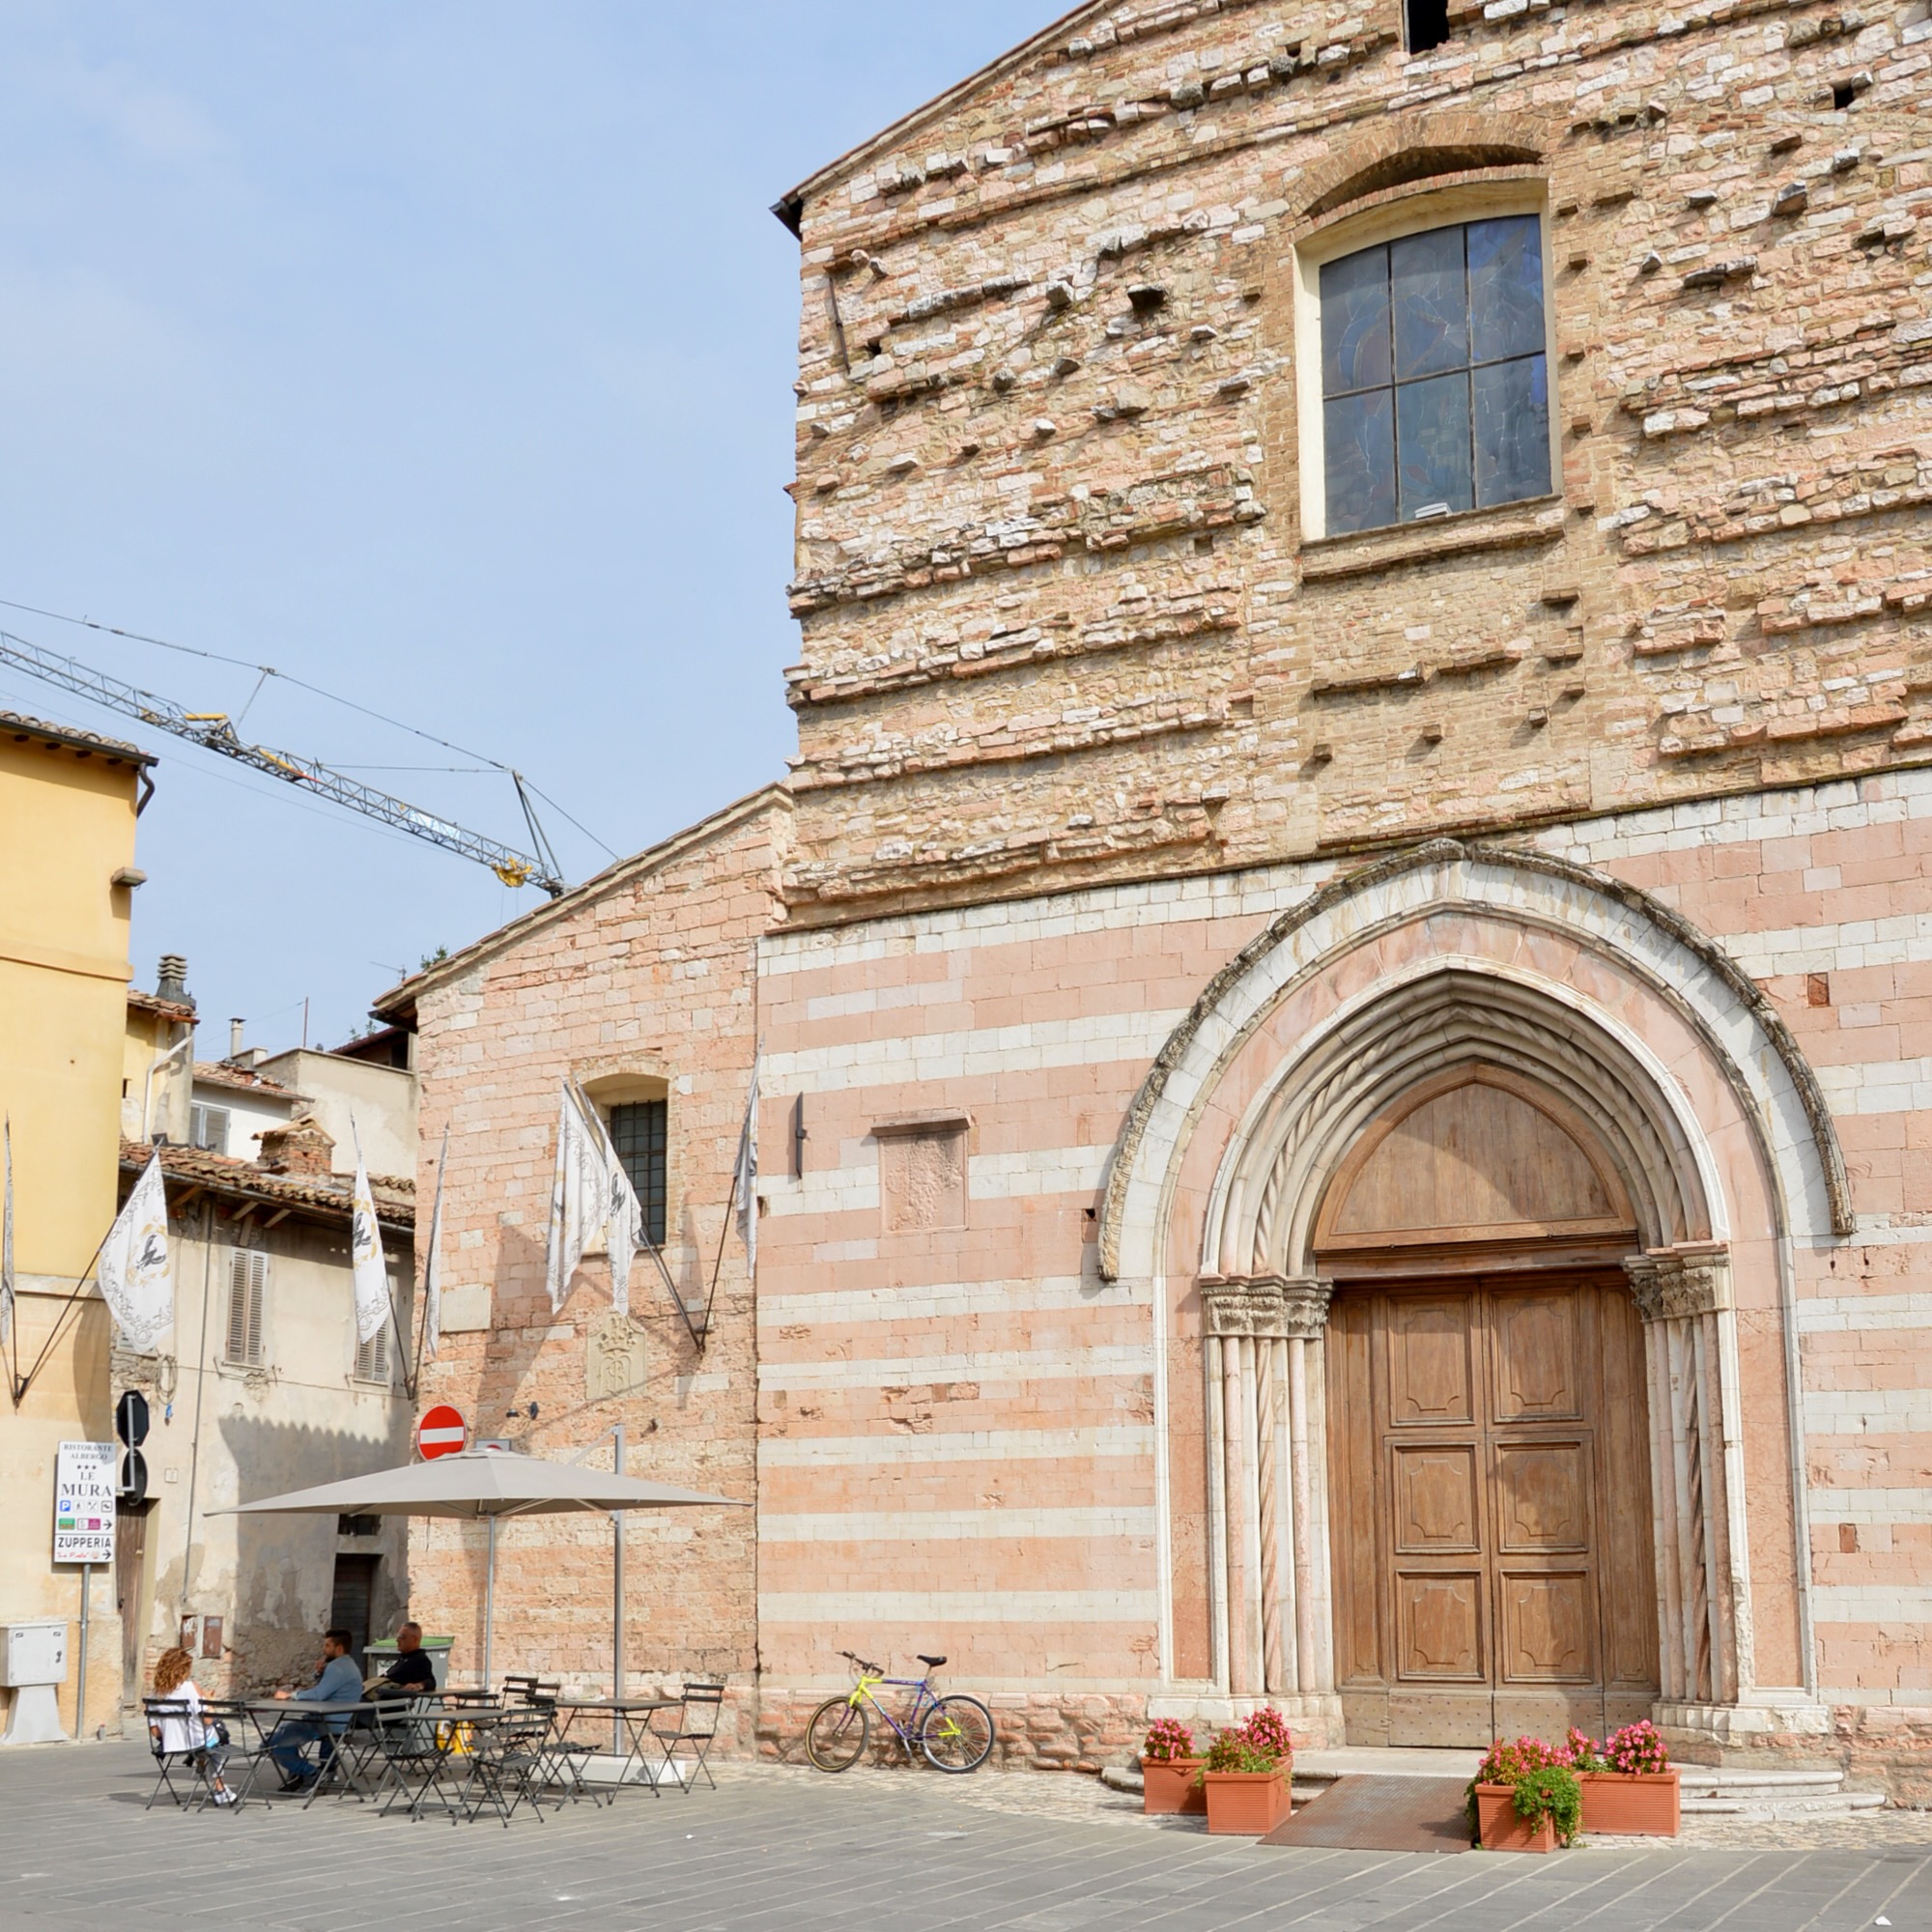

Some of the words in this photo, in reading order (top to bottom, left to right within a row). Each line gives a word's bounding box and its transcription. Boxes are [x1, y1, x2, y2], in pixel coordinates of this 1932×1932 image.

[64, 1443, 112, 1452] RISTORANTE
[80, 1471, 96, 1481] LE
[61, 1484, 112, 1496] MURA
[58, 1537, 111, 1548] ZUPPERIA
